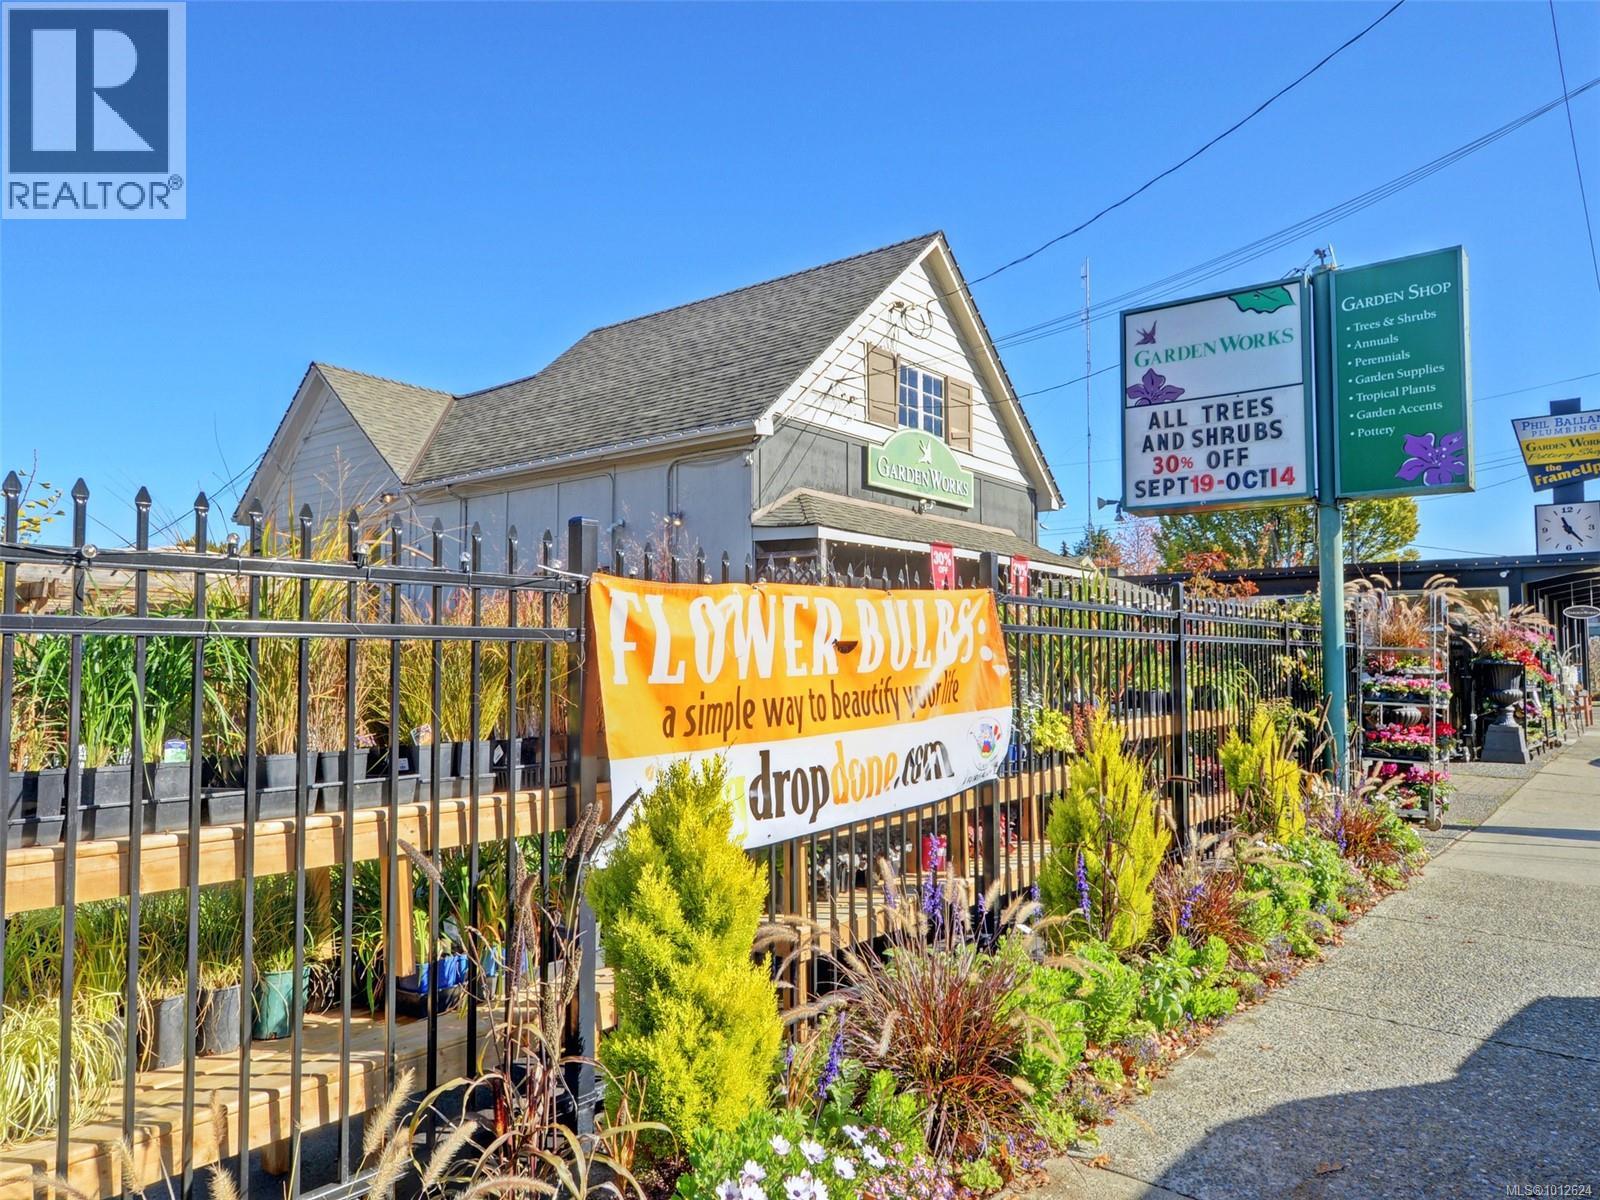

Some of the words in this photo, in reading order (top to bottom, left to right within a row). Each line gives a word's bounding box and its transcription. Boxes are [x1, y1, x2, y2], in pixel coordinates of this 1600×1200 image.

[1341, 290, 1404, 312] GARDEN
[1408, 281, 1452, 300] SHOP
[1353, 319, 1381, 332] Trees
[1382, 316, 1395, 327] &
[1397, 309, 1437, 325] Shrubs
[1354, 334, 1399, 349] Annuals
[1355, 350, 1411, 367] Perennials
[1355, 371, 1395, 385] Garden
[1396, 364, 1445, 379] Supplies
[1356, 386, 1399, 402] Tropical
[1402, 383, 1437, 396] Plants
[1149, 409, 1188, 430] ALL
[1201, 396, 1274, 424] TREES
[1356, 406, 1396, 420] Garden
[1398, 401, 1443, 415] Accents
[1357, 426, 1395, 438] Pottery
[1521, 420, 1550, 431] PHIL
[1531, 424, 1598, 438] PLUMBING
[1142, 432, 1185, 453] AND
[1191, 419, 1283, 449] SHRUBS
[1152, 455, 1194, 475] 30%
[1206, 447, 1249, 470] OFF
[1545, 464, 1562, 472] the
[933, 551, 952, 567] 30%
[609, 587, 842, 685] FLOWER
[662, 704, 676, 738] a
[683, 686, 756, 742] simple
[762, 694, 804, 733] way
[808, 688, 826, 722] to
[830, 676, 900, 720] beautify
[941, 669, 959, 705] life
